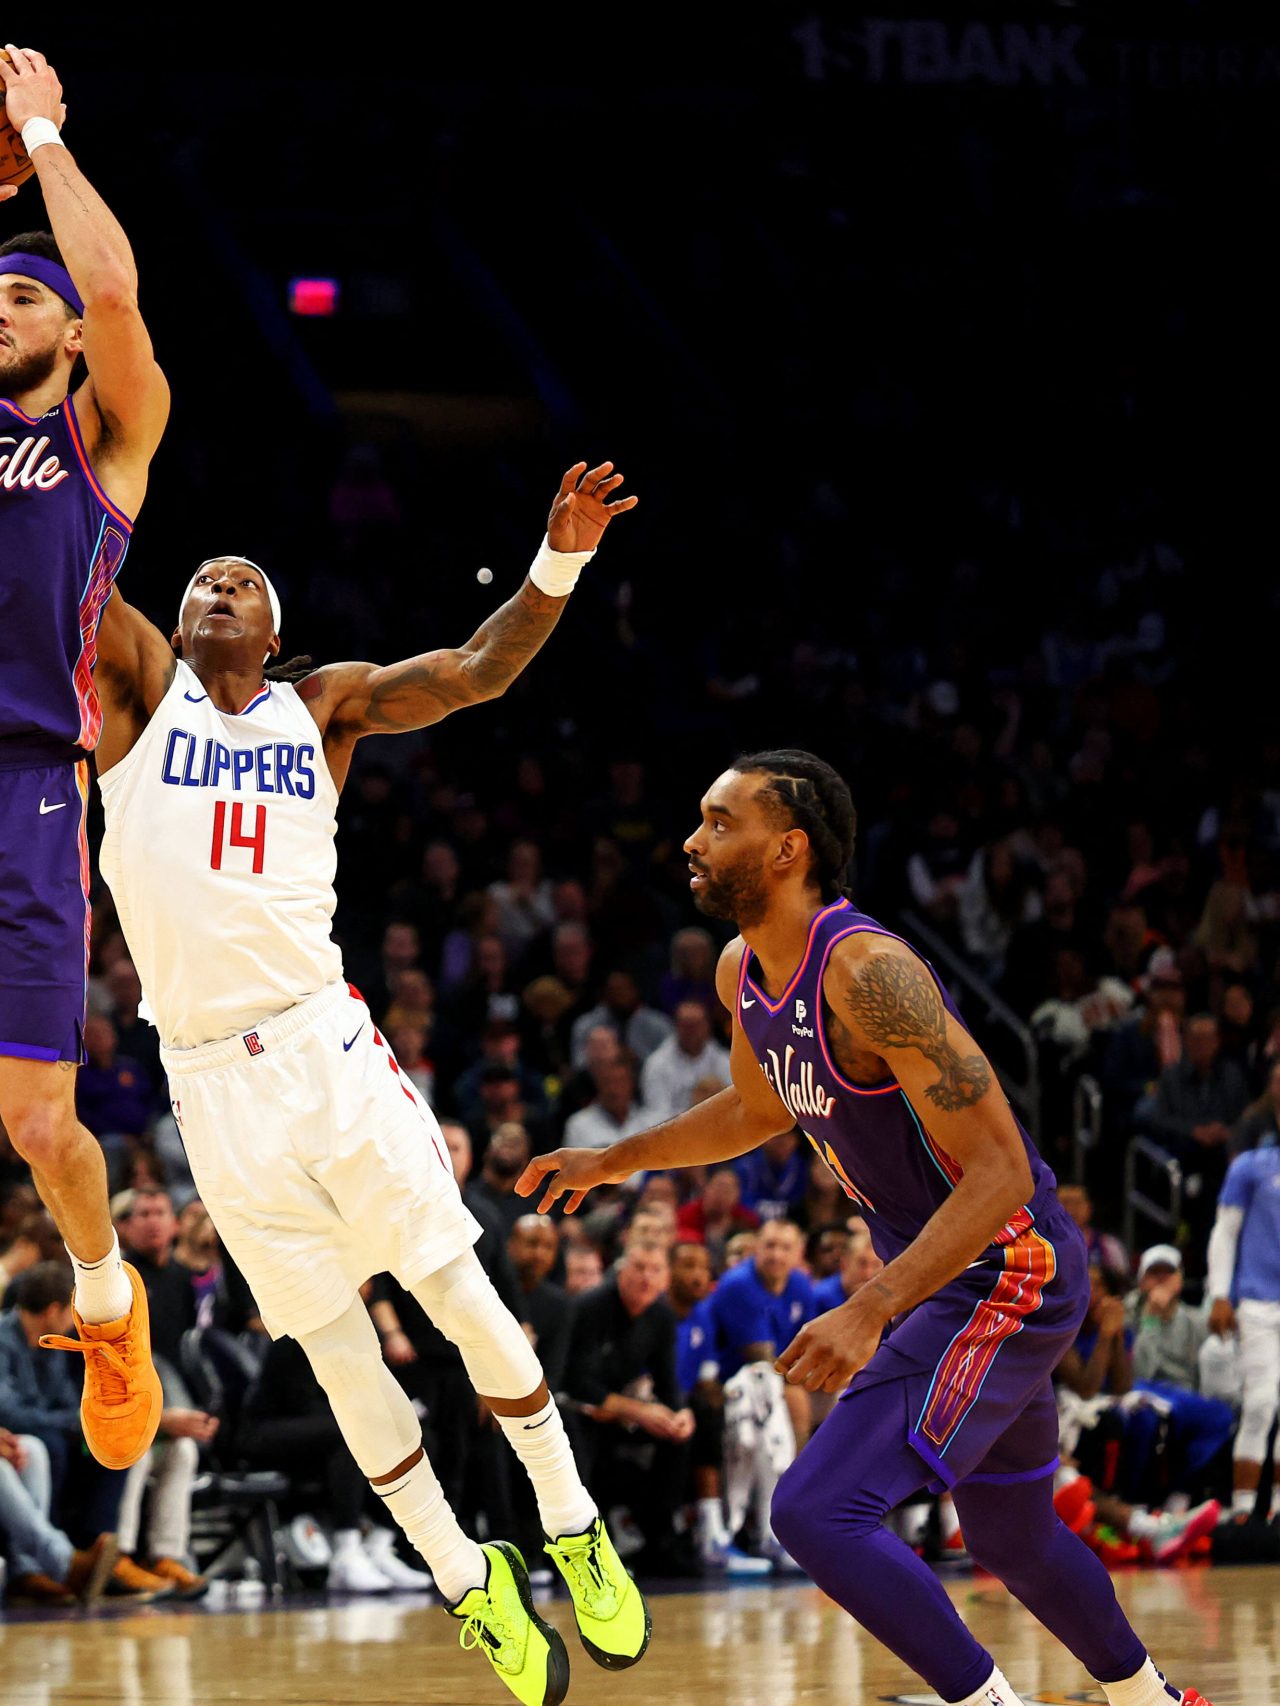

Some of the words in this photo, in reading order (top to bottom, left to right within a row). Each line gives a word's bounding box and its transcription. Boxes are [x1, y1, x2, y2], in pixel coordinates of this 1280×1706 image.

[161, 727, 315, 800] CLIPPERS
[210, 800, 267, 874] 14
[791, 1024, 814, 1038] PayPal
[766, 1044, 837, 1121] Valle
